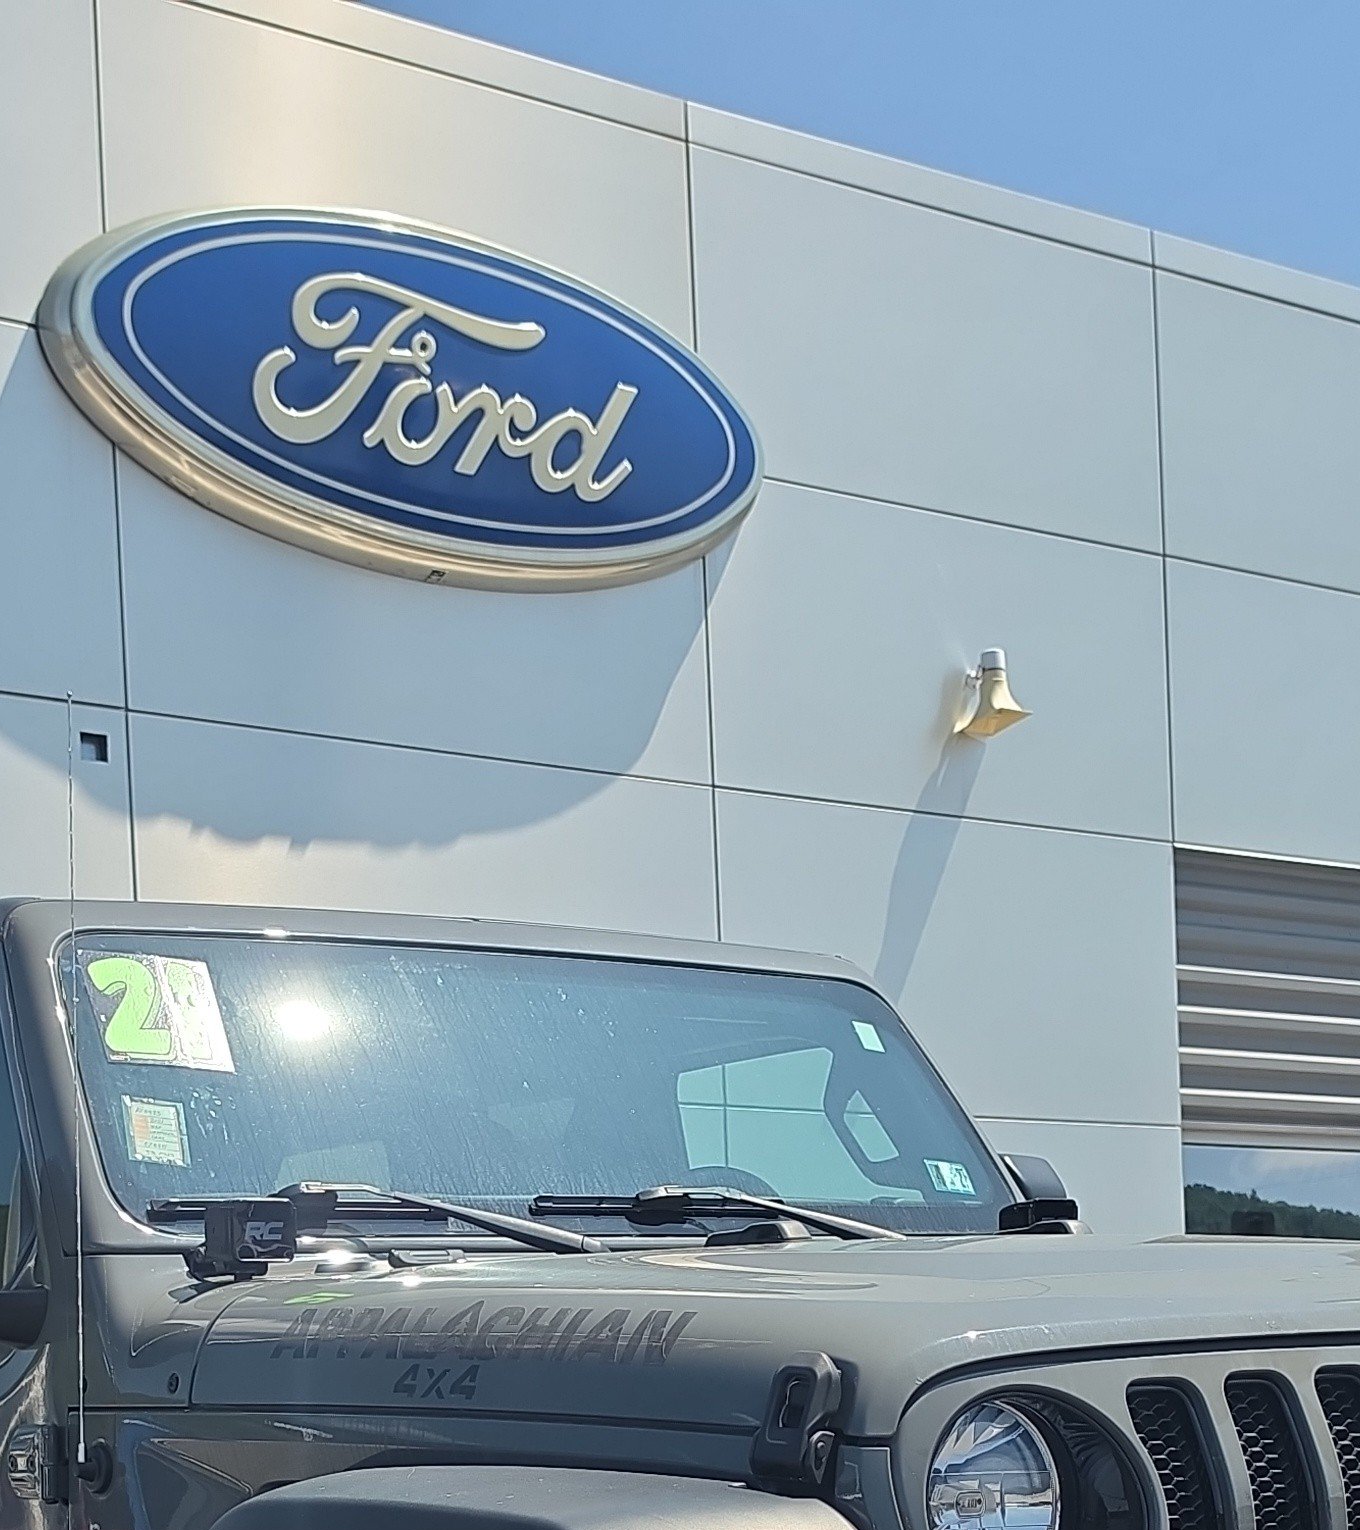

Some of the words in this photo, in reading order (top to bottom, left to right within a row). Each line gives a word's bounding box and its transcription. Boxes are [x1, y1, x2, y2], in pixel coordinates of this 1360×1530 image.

[251, 272, 634, 503] Ford
[245, 1221, 284, 1240] RC
[270, 1299, 698, 1367] APPALACHIAN
